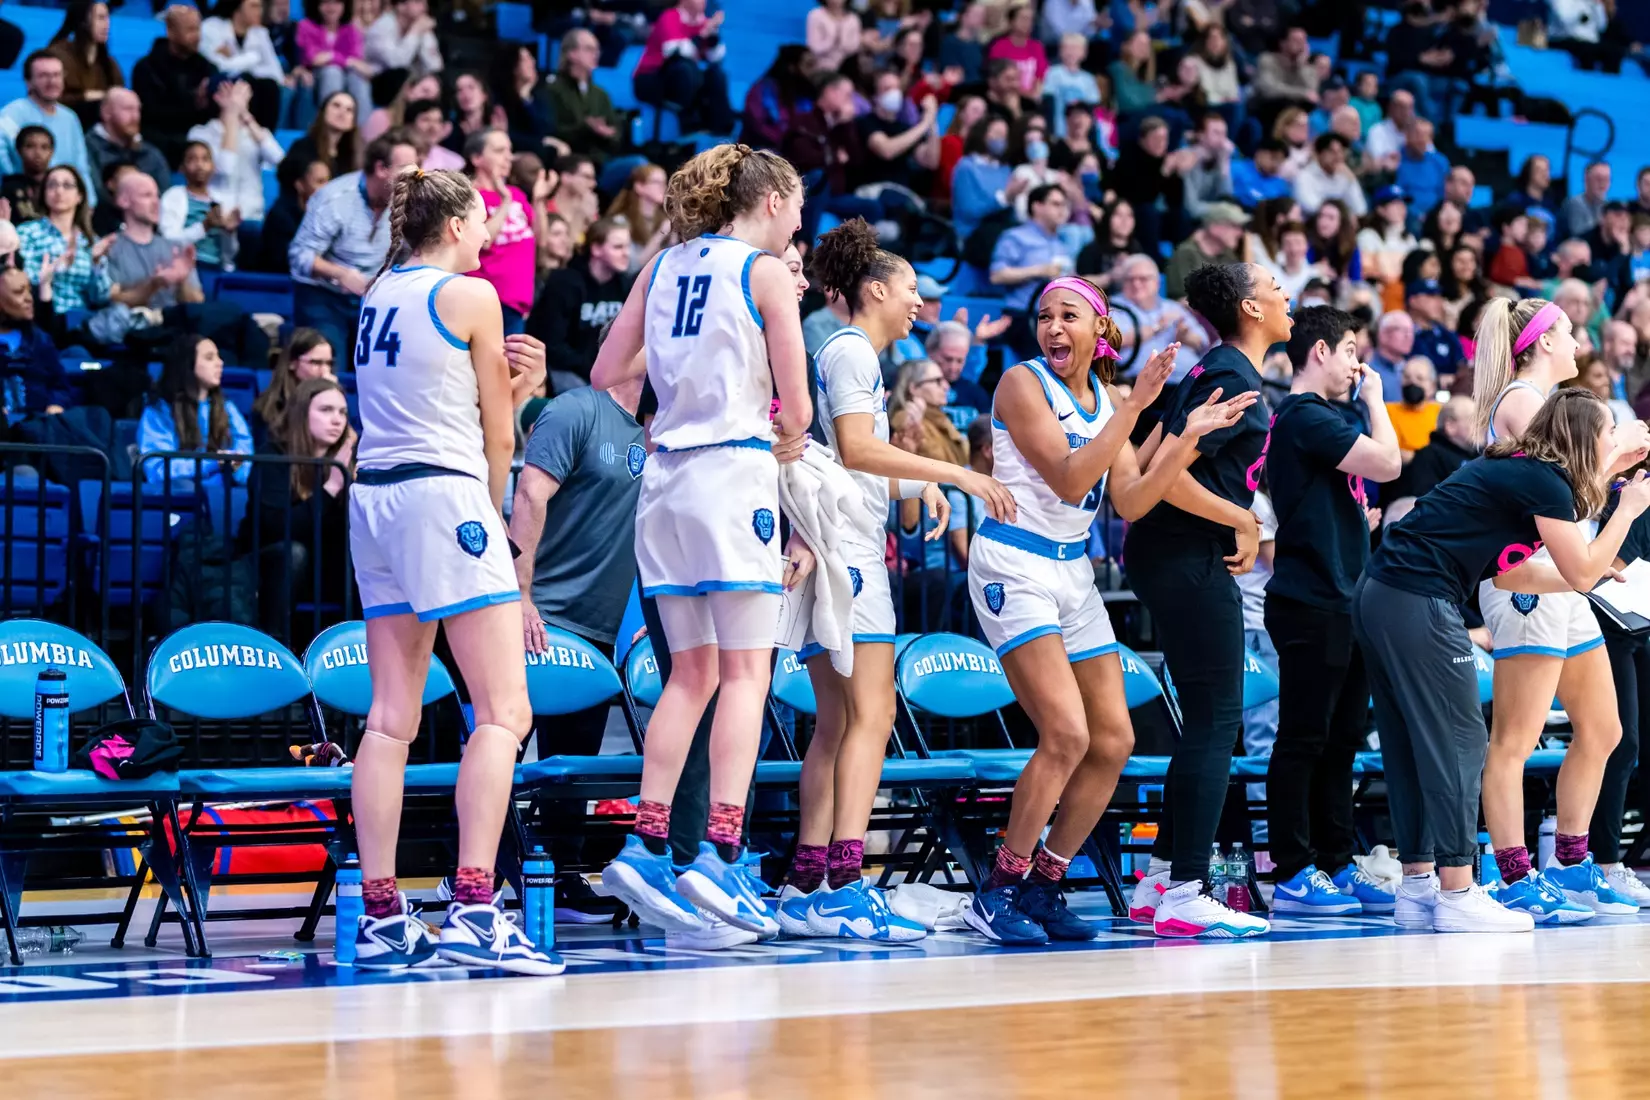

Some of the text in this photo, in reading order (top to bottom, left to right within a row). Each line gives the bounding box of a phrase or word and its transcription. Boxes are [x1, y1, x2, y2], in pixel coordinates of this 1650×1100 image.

[671, 275, 712, 338] 12
[356, 306, 401, 367] 34
[0, 641, 94, 669] LUMBIA
[169, 644, 283, 673] COLUMBIA
[322, 643, 368, 670] COLU
[525, 645, 596, 670] UMBIA
[914, 652, 1001, 677] COLUMBIA
